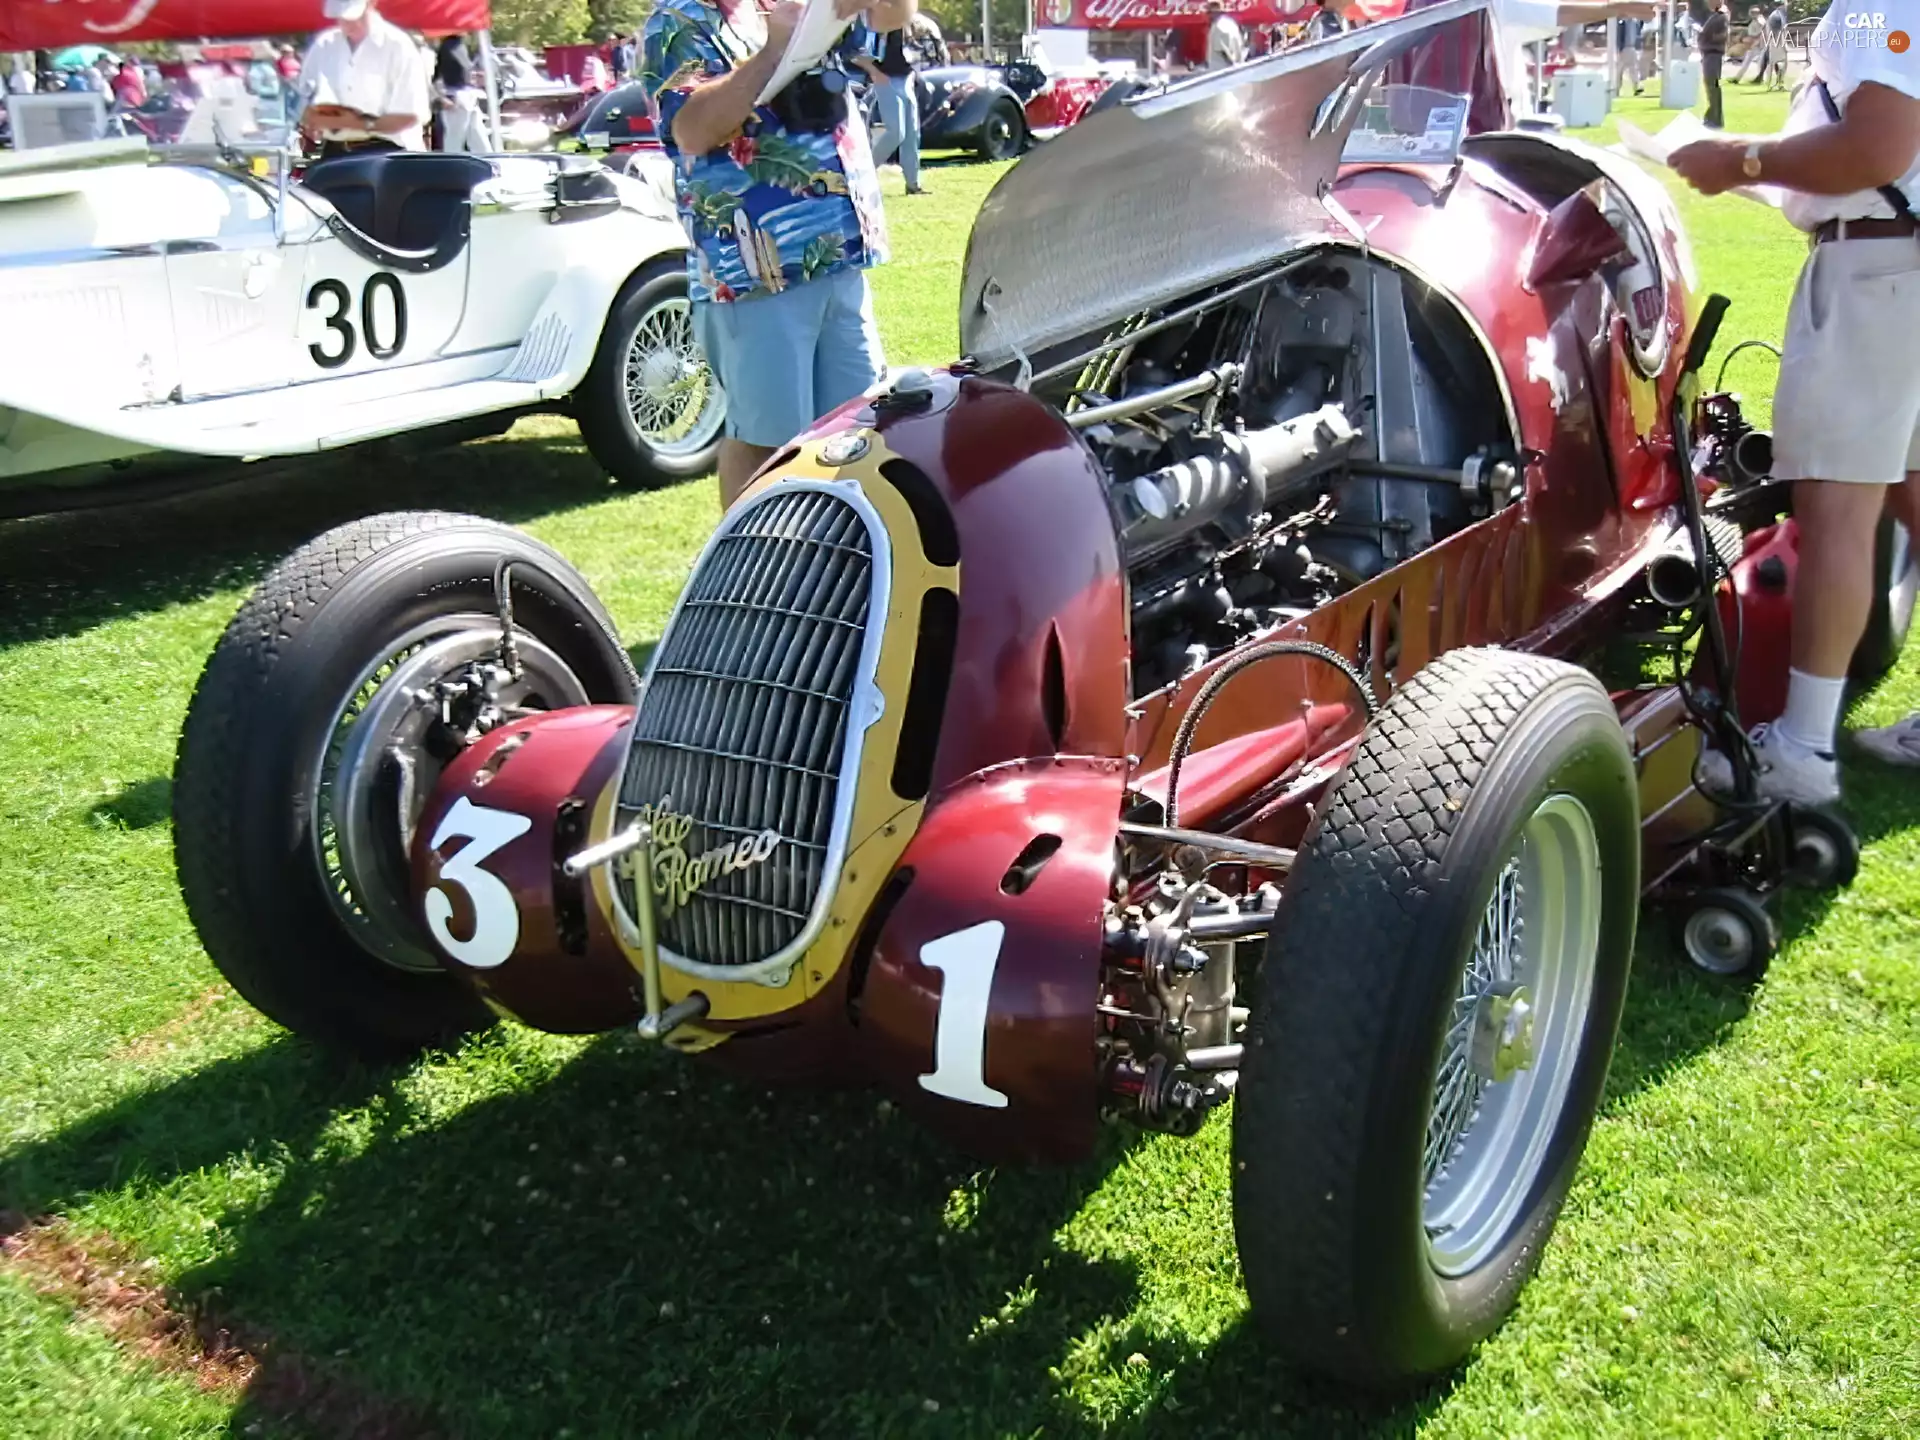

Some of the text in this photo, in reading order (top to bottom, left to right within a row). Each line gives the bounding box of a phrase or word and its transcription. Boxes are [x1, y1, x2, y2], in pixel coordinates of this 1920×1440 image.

[305, 271, 408, 369] 30
[424, 795, 532, 969] 3
[653, 830, 782, 919] Romeo
[917, 919, 1010, 1109] 1
